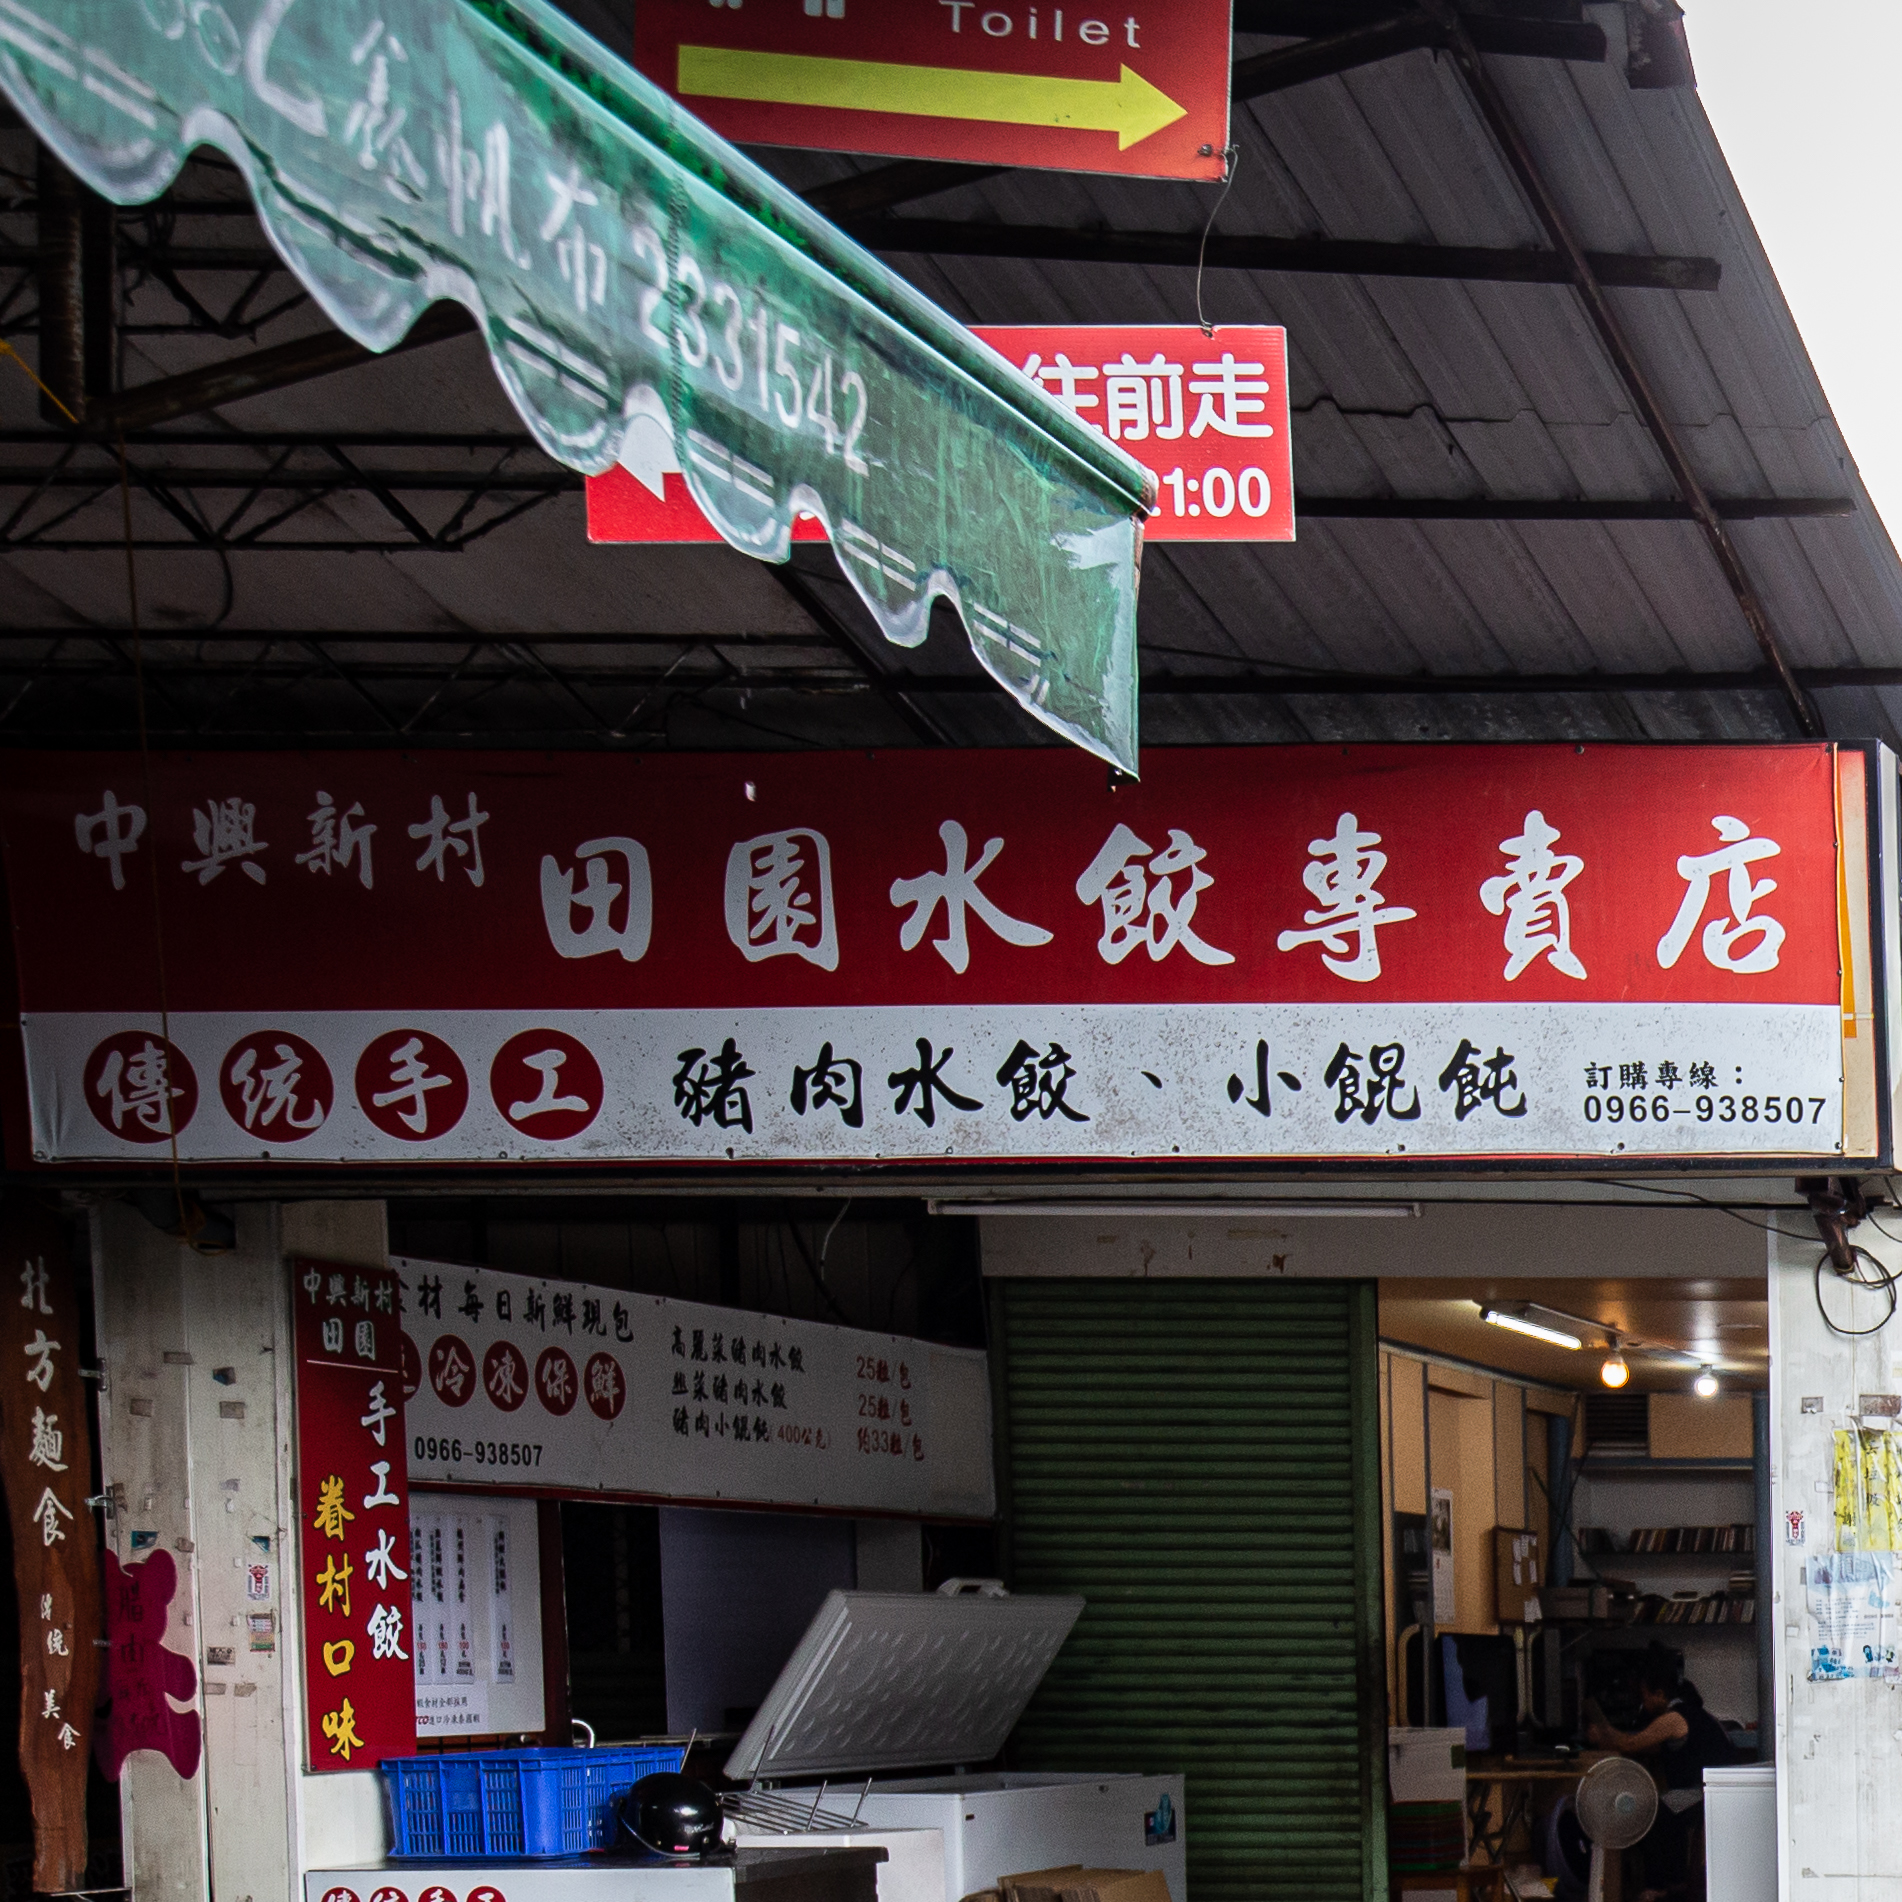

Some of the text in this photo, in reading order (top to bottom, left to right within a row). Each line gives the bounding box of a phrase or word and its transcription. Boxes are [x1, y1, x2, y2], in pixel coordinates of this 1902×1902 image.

[940, 0, 1142, 50] Toilet
[1151, 466, 1272, 518] 1:00
[74, 790, 1787, 983] 中興新村 田園水餃專賣店
[95, 1036, 590, 1136] 傳統手工
[1583, 1094, 1828, 1126] 0966-938507
[303, 1266, 393, 1315] 中興新村
[399, 1274, 635, 1344] 材每日新鮮現包
[322, 1317, 376, 1361] 田園
[414, 1436, 543, 1468] 0966-938507
[360, 1379, 409, 1662] 手工水餃
[313, 1474, 365, 1762] 眷村口味
